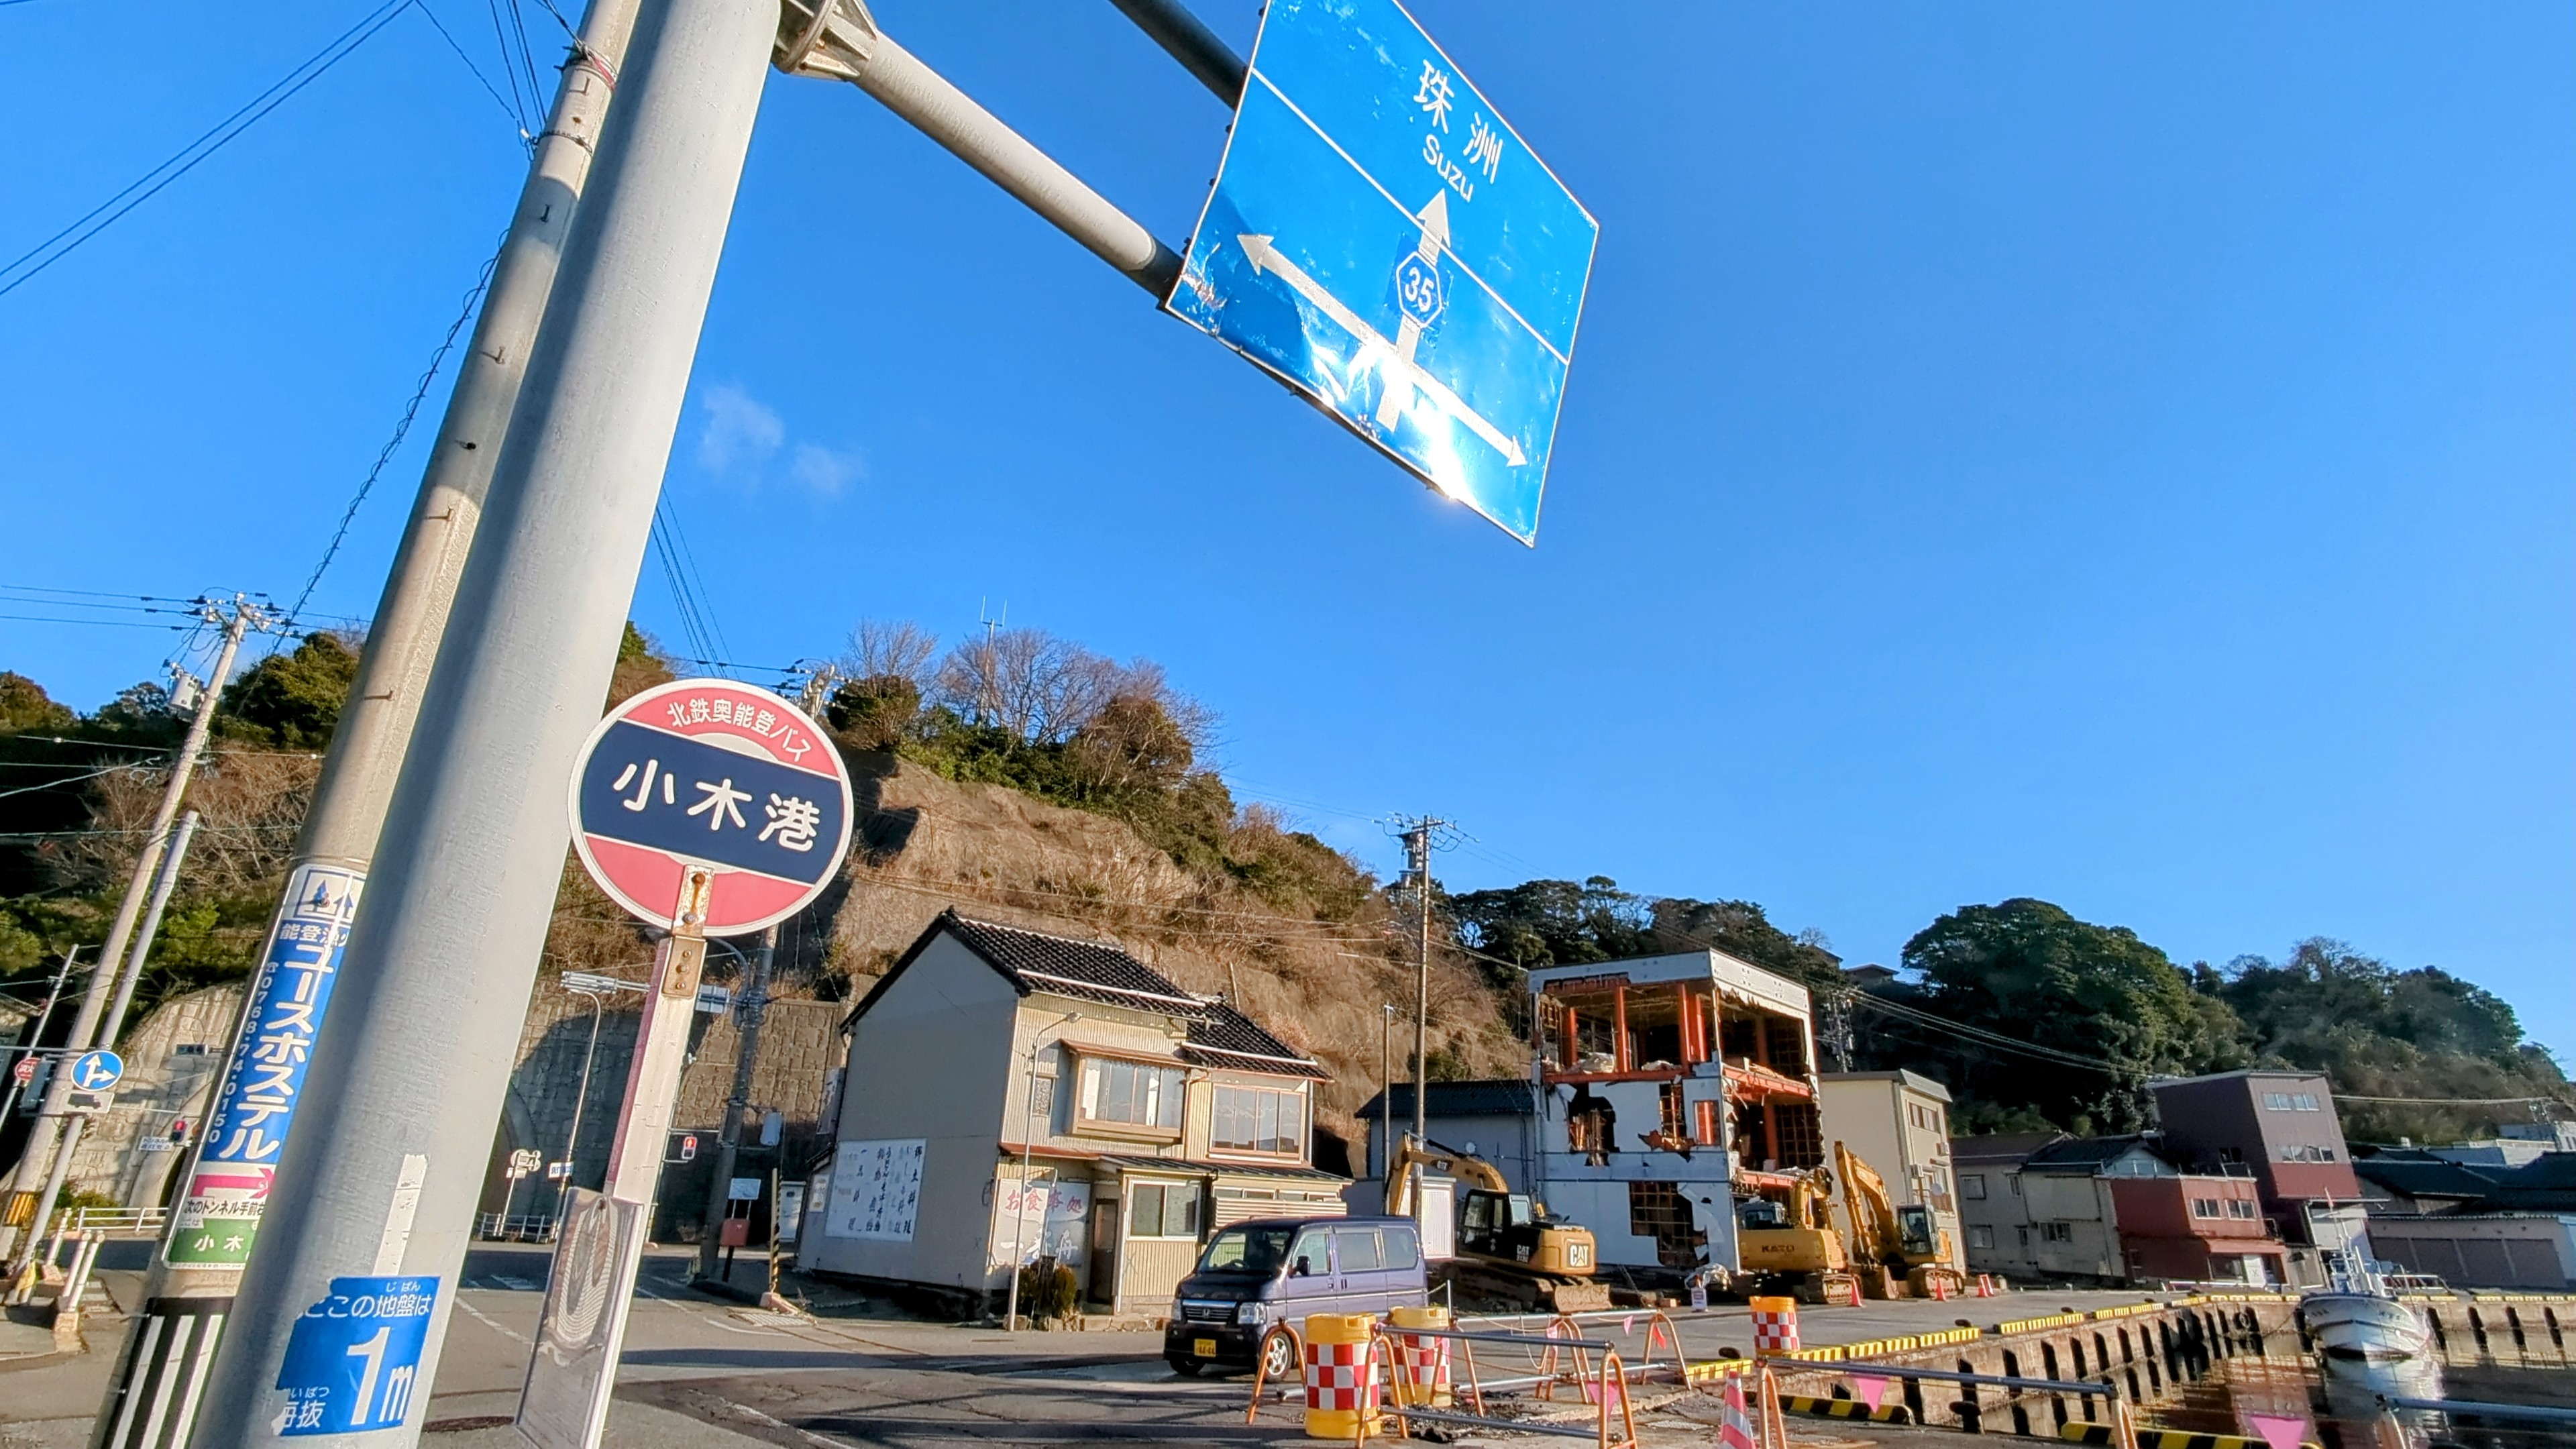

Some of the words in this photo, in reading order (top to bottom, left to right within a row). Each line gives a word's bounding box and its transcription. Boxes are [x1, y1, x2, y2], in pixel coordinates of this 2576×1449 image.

[1413, 60, 1503, 184] 珠洲
[1422, 134, 1474, 203] Suzu
[1405, 266, 1434, 313] 35
[667, 698, 811, 762] 北鉄奥能登バス
[613, 759, 820, 851] 小木港
[219, 945, 334, 1160] ユースホステル
[1005, 1188, 1083, 1214] お食事処
[1516, 1244, 1529, 1255] CAT
[1570, 1244, 1589, 1267] CAT
[284, 1386, 331, 1399] いばつ
